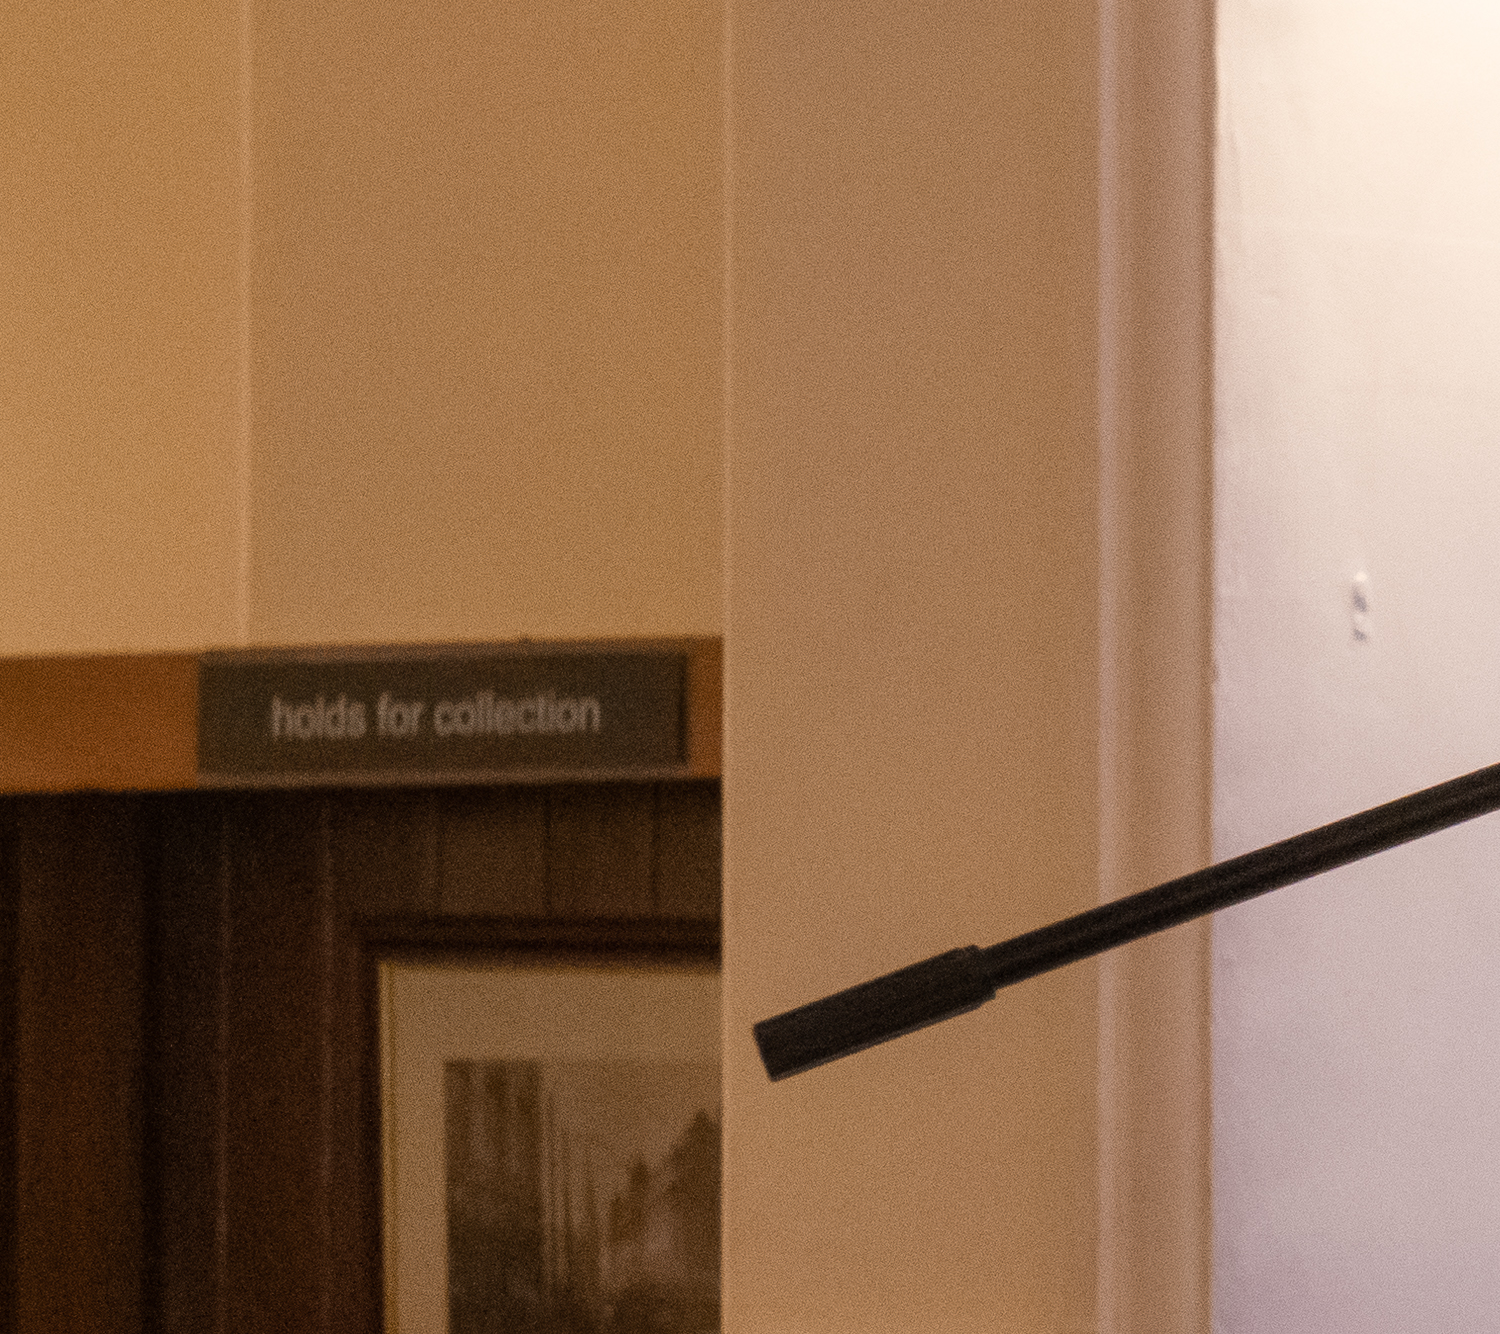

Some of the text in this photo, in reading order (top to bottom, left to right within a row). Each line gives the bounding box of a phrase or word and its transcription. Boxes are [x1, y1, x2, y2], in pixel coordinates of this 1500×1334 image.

[271, 687, 601, 741] holds for collection
